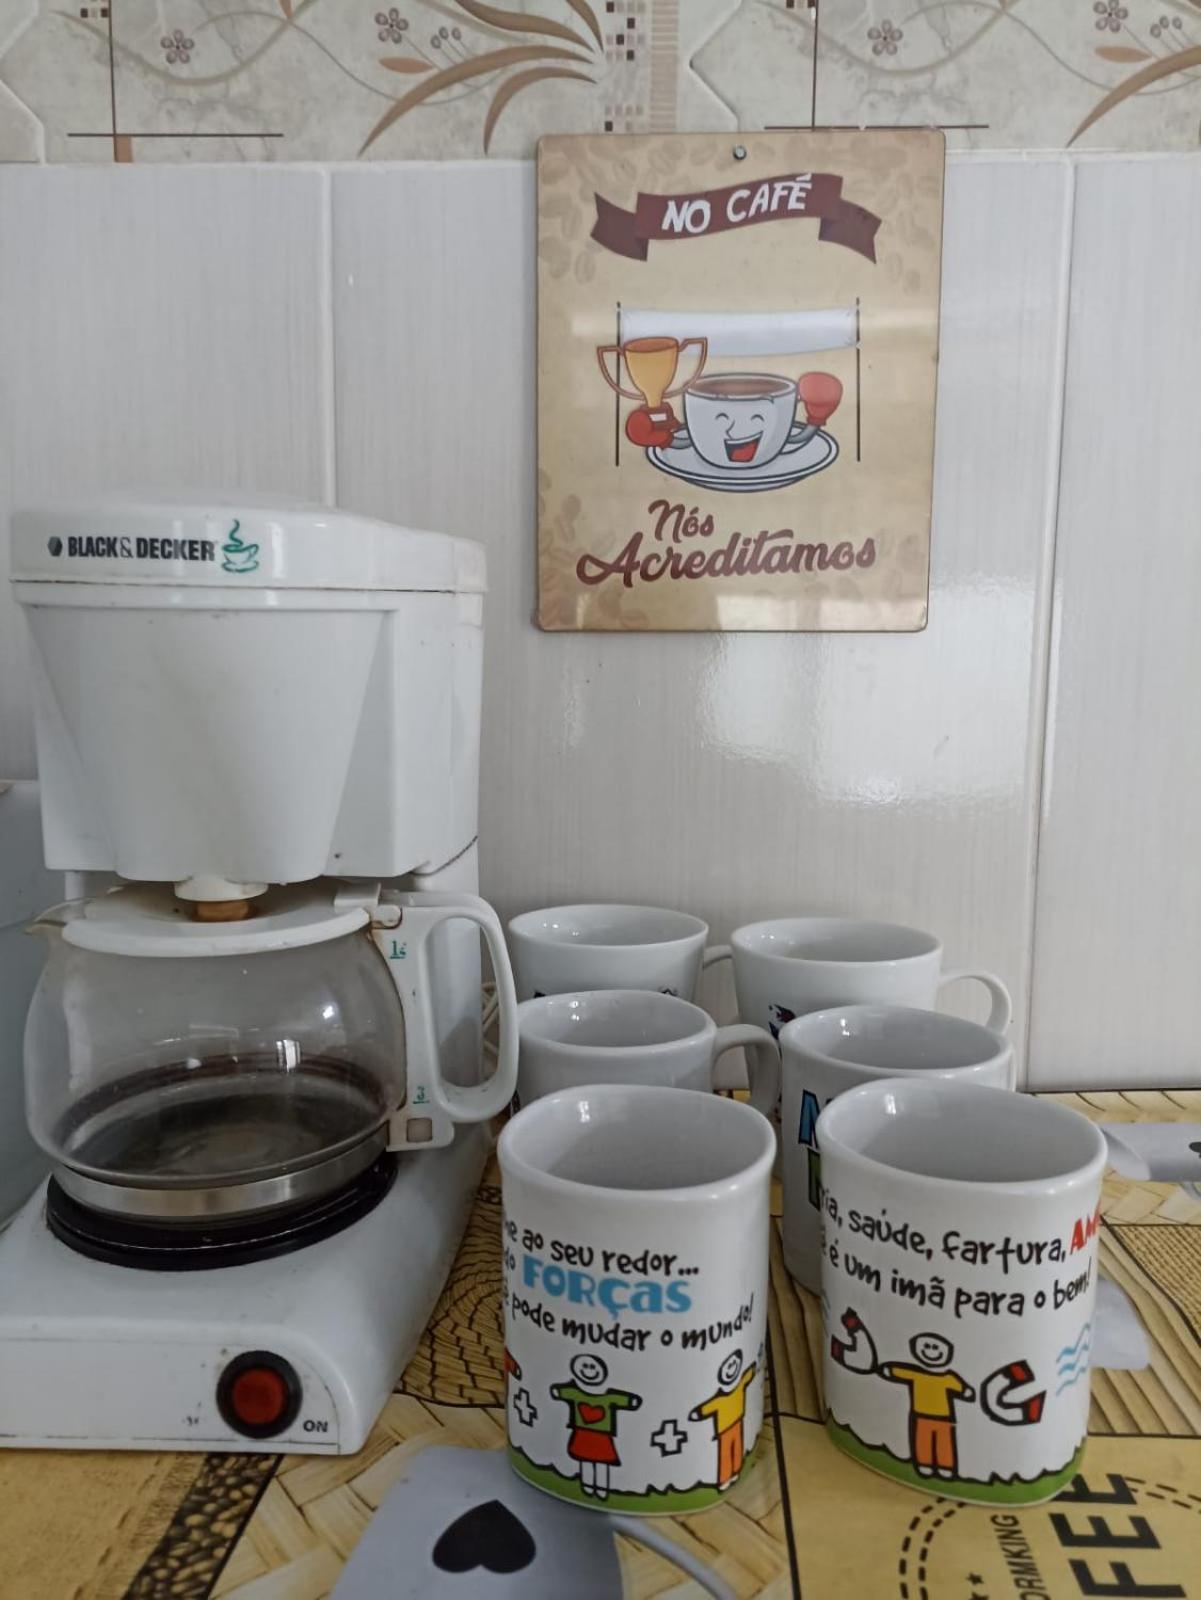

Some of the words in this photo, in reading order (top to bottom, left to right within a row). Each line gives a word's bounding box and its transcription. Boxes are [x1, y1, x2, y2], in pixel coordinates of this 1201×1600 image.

[661, 199, 711, 233] NO
[726, 172, 812, 223] CAFÉ
[647, 498, 715, 543] Nós
[576, 528, 876, 588] Acreditamos
[522, 1228, 544, 1252] ao
[550, 1240, 594, 1267] seu
[848, 1208, 933, 1260] saúde,
[941, 1230, 1067, 1274] fartura,
[845, 1253, 881, 1292] um
[890, 1269, 946, 1309] imã
[954, 1287, 1025, 1319] para
[1034, 1291, 1046, 1308] o
[511, 1295, 556, 1332] pode
[562, 1318, 651, 1351] mudar
[661, 1328, 673, 1346] o
[681, 1292, 754, 1351] mundo!
[303, 1420, 328, 1433] ON
